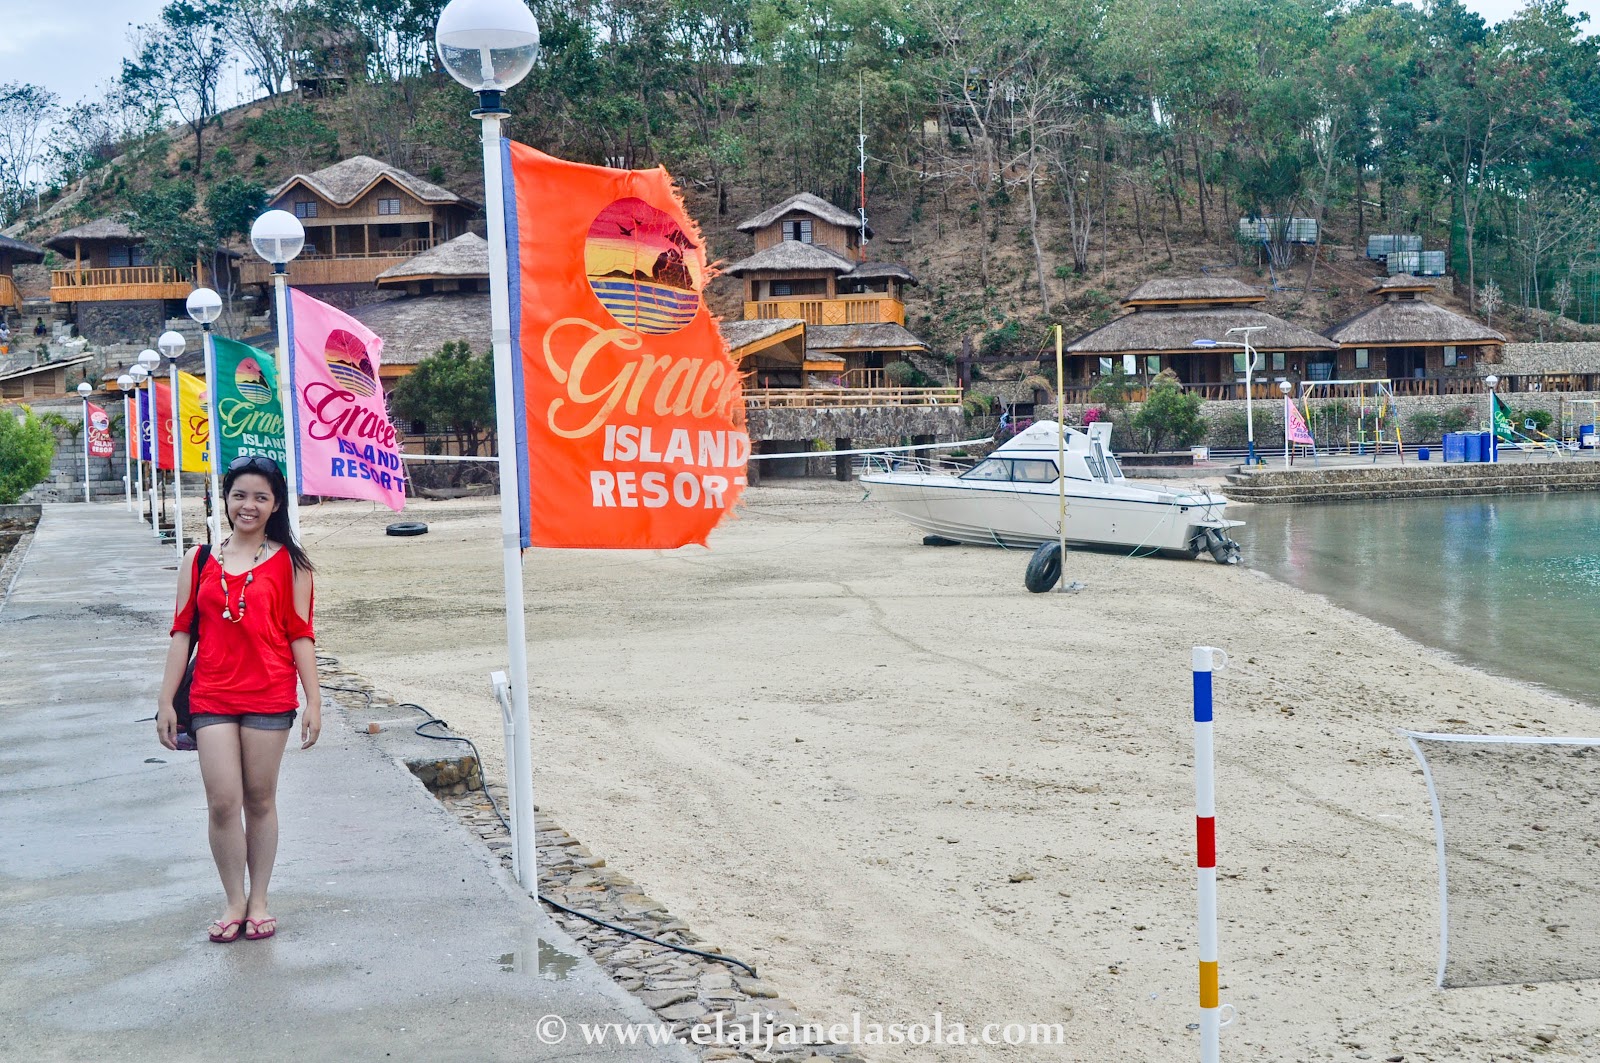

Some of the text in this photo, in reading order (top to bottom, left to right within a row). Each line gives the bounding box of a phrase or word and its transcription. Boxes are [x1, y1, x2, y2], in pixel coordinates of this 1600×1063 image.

[218, 398, 284, 438] Grace
[304, 382, 395, 448] Grace
[238, 447, 287, 462] RESOR
[337, 437, 400, 471] ISLAND
[603, 425, 750, 468] ISLAND
[331, 457, 404, 492] RESORT
[590, 470, 747, 509] RESOR
